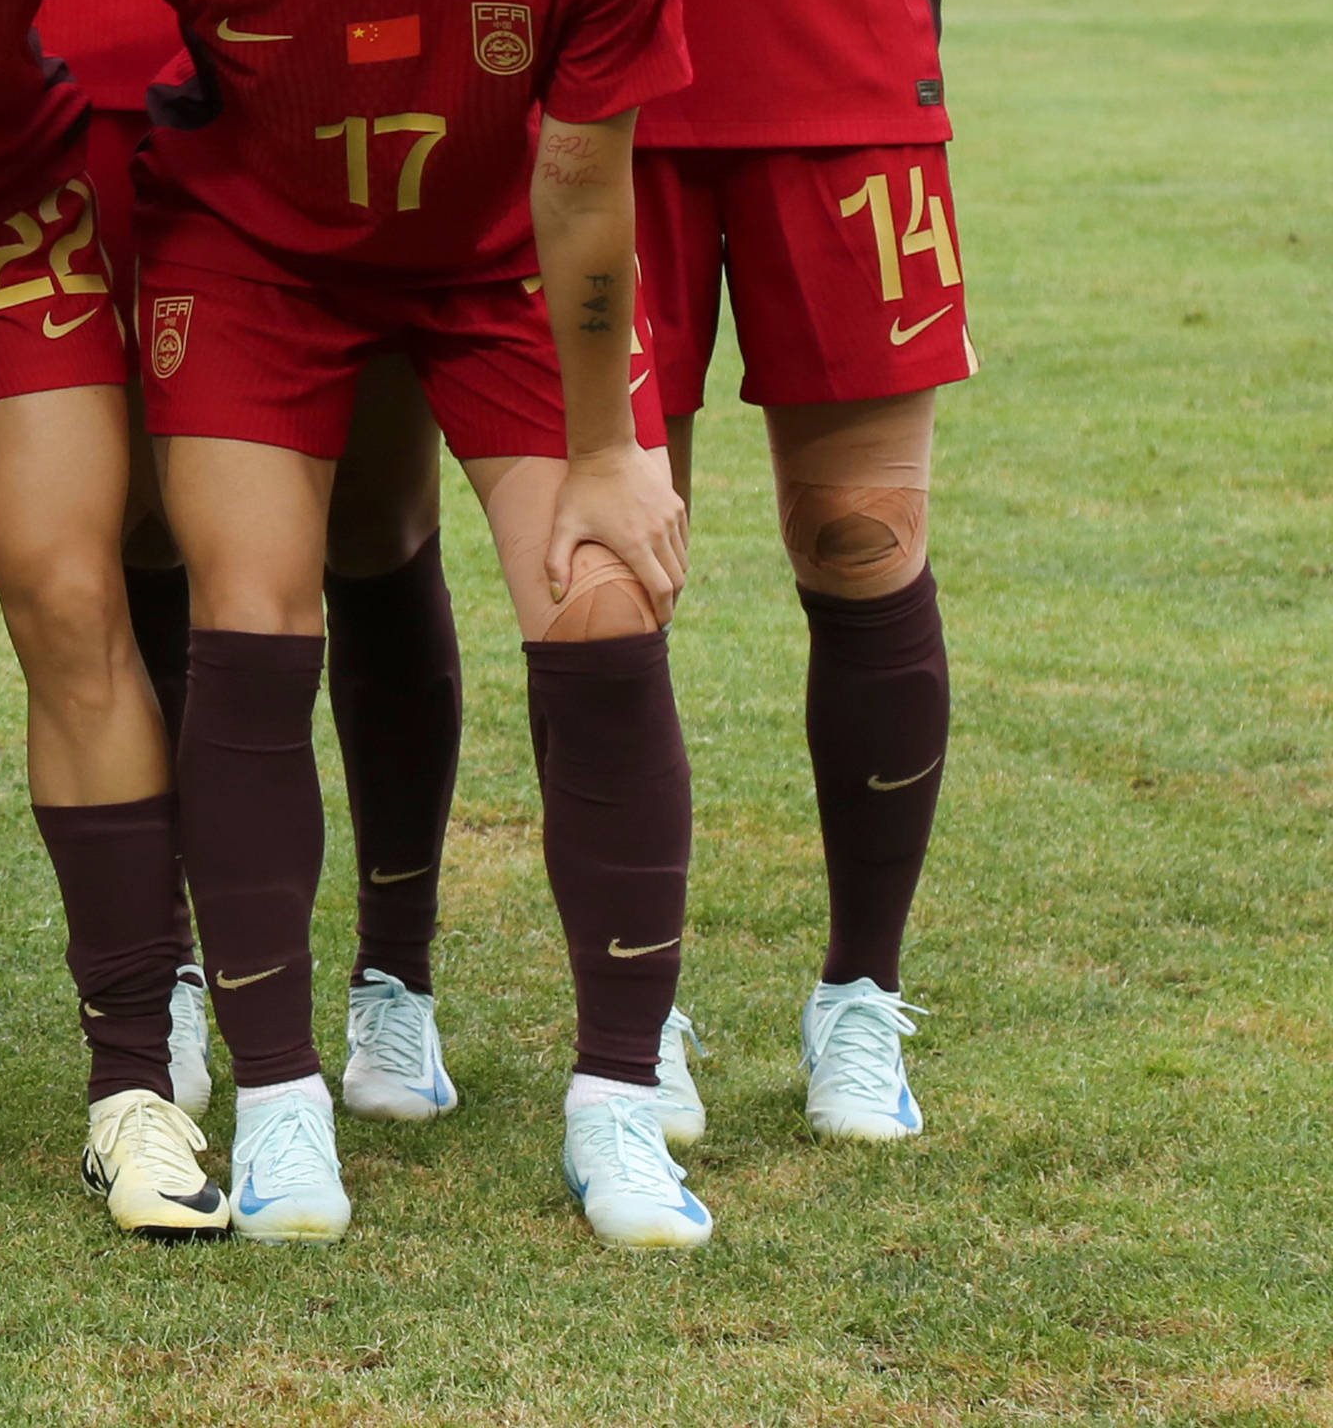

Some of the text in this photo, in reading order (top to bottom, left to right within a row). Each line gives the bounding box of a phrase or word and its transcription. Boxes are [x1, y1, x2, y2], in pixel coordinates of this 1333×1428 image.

[477, 7, 526, 22] CFA
[315, 112, 447, 212] 17
[839, 166, 961, 302] 14
[156, 301, 189, 319] CFA
